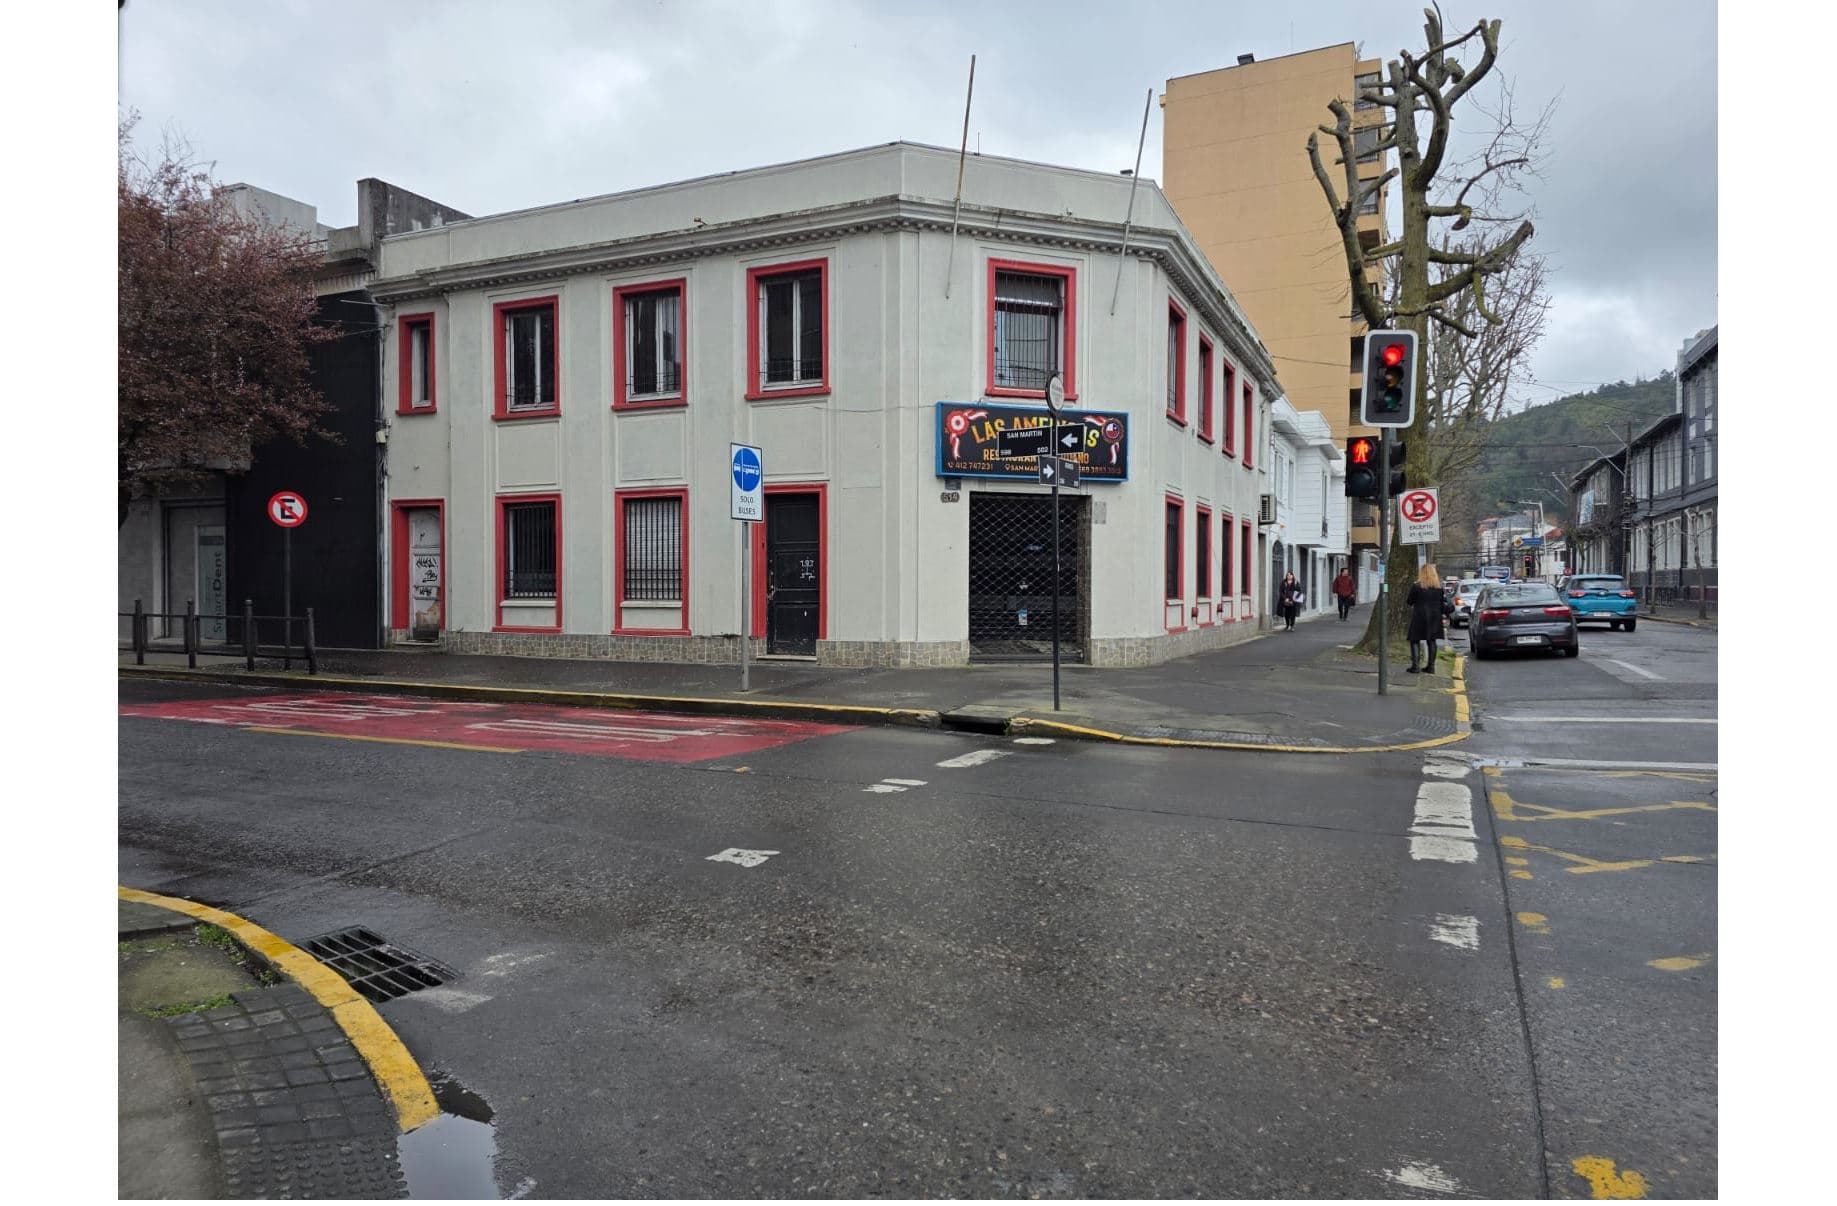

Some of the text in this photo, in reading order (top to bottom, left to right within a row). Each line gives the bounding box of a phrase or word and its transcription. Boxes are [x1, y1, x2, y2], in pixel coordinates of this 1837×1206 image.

[971, 418, 1006, 444] LAS
[1020, 430, 1043, 438] MARTIN
[740, 496, 754, 504] SOLO
[738, 506, 756, 515] BUSES
